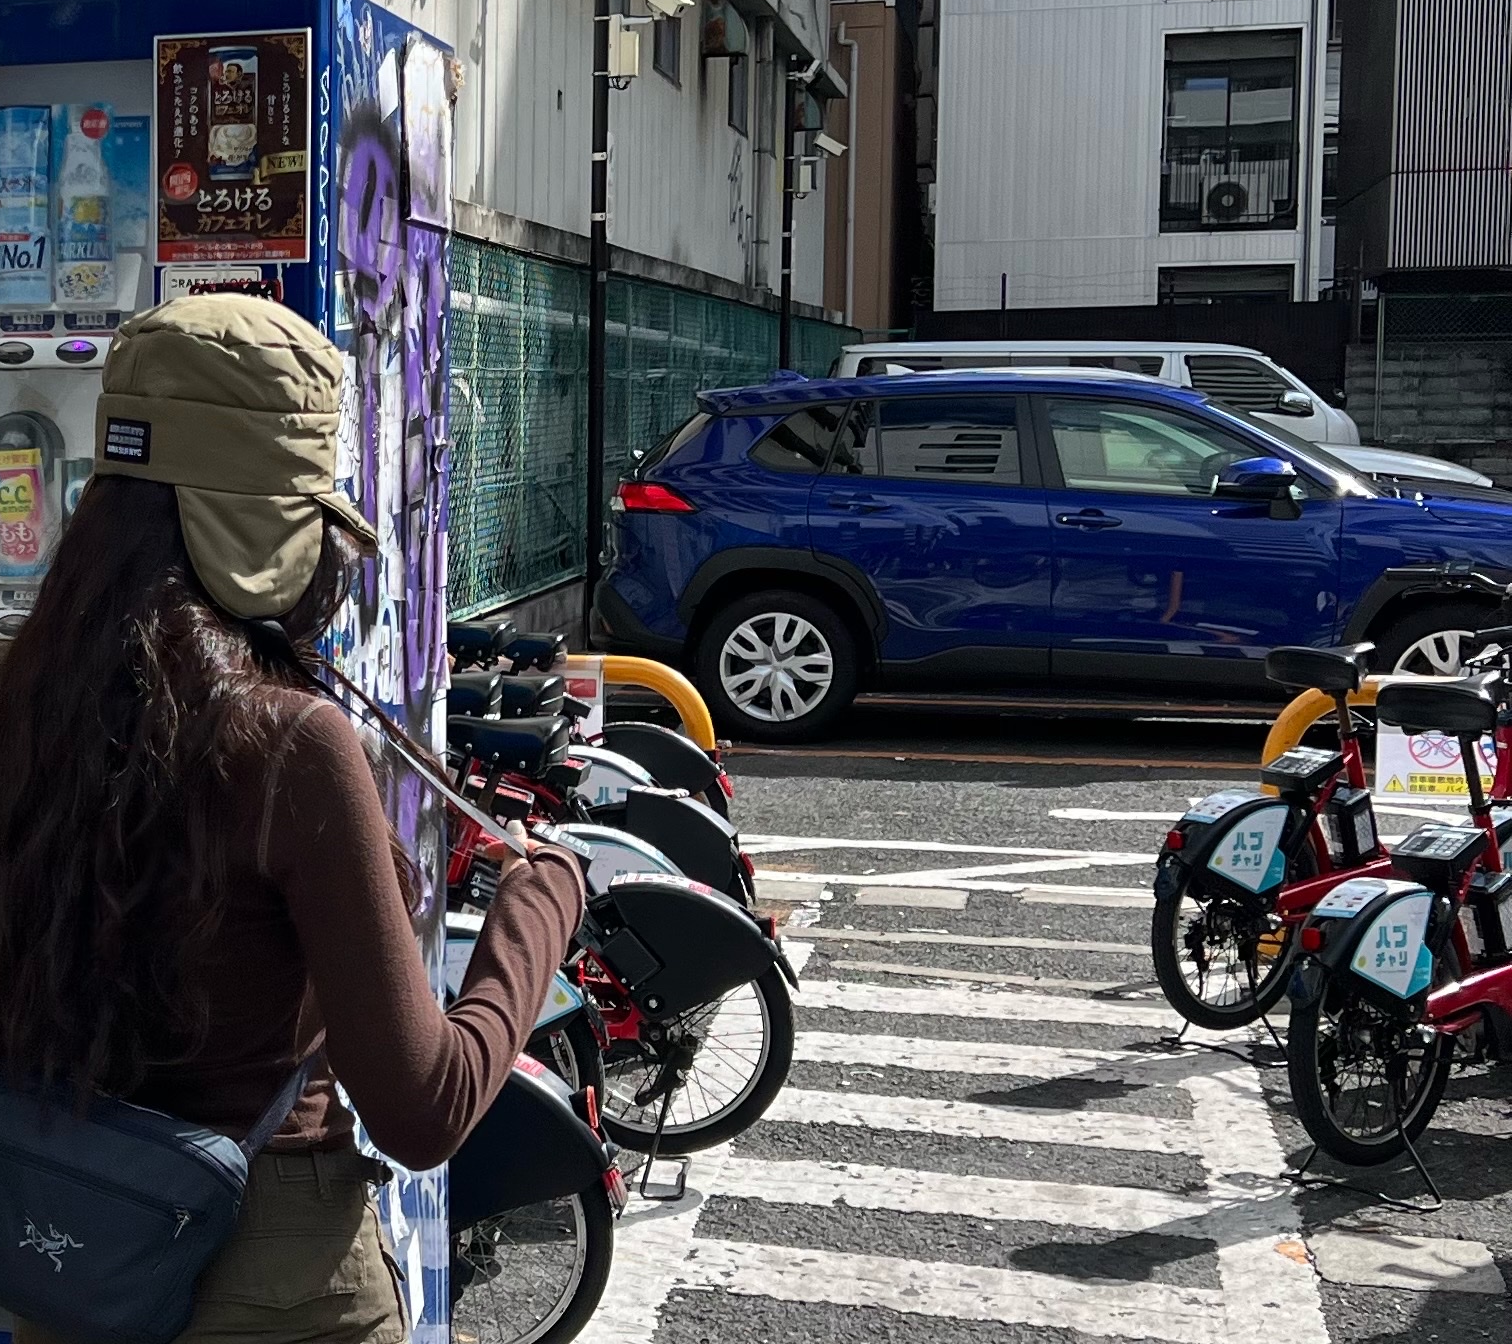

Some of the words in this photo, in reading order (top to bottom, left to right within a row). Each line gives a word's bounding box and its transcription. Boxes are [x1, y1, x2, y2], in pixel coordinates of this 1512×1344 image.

[214, 90, 253, 105] とろける
[267, 155, 304, 171] NEW!
[196, 188, 273, 213] とろける
[197, 212, 272, 233] カフェオレ
[3, 235, 47, 270] No.1
[0, 521, 33, 543] もも
[1231, 854, 1263, 867] チャリ
[1375, 949, 1408, 968] チャリ
